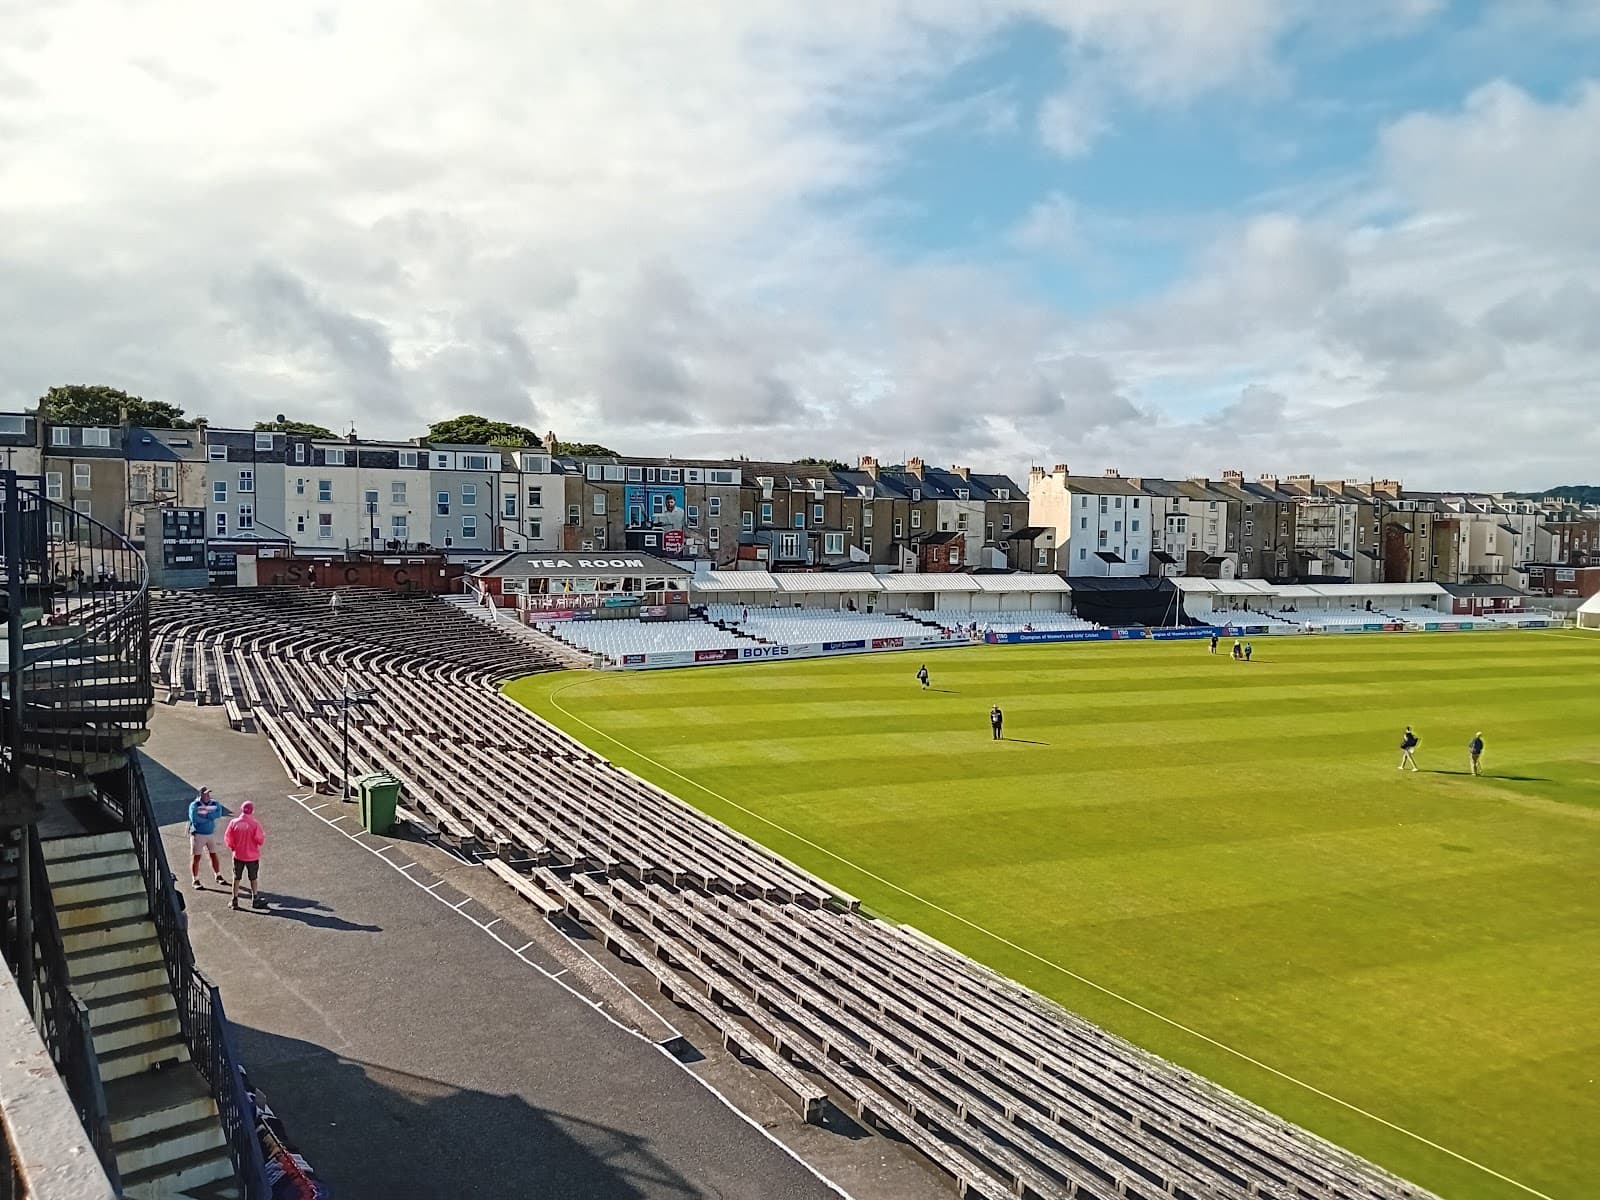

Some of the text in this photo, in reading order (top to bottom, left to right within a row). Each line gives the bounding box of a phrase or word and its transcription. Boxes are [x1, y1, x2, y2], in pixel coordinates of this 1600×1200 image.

[527, 559, 644, 568] TEA ROOM
[743, 646, 789, 658] BOYES
